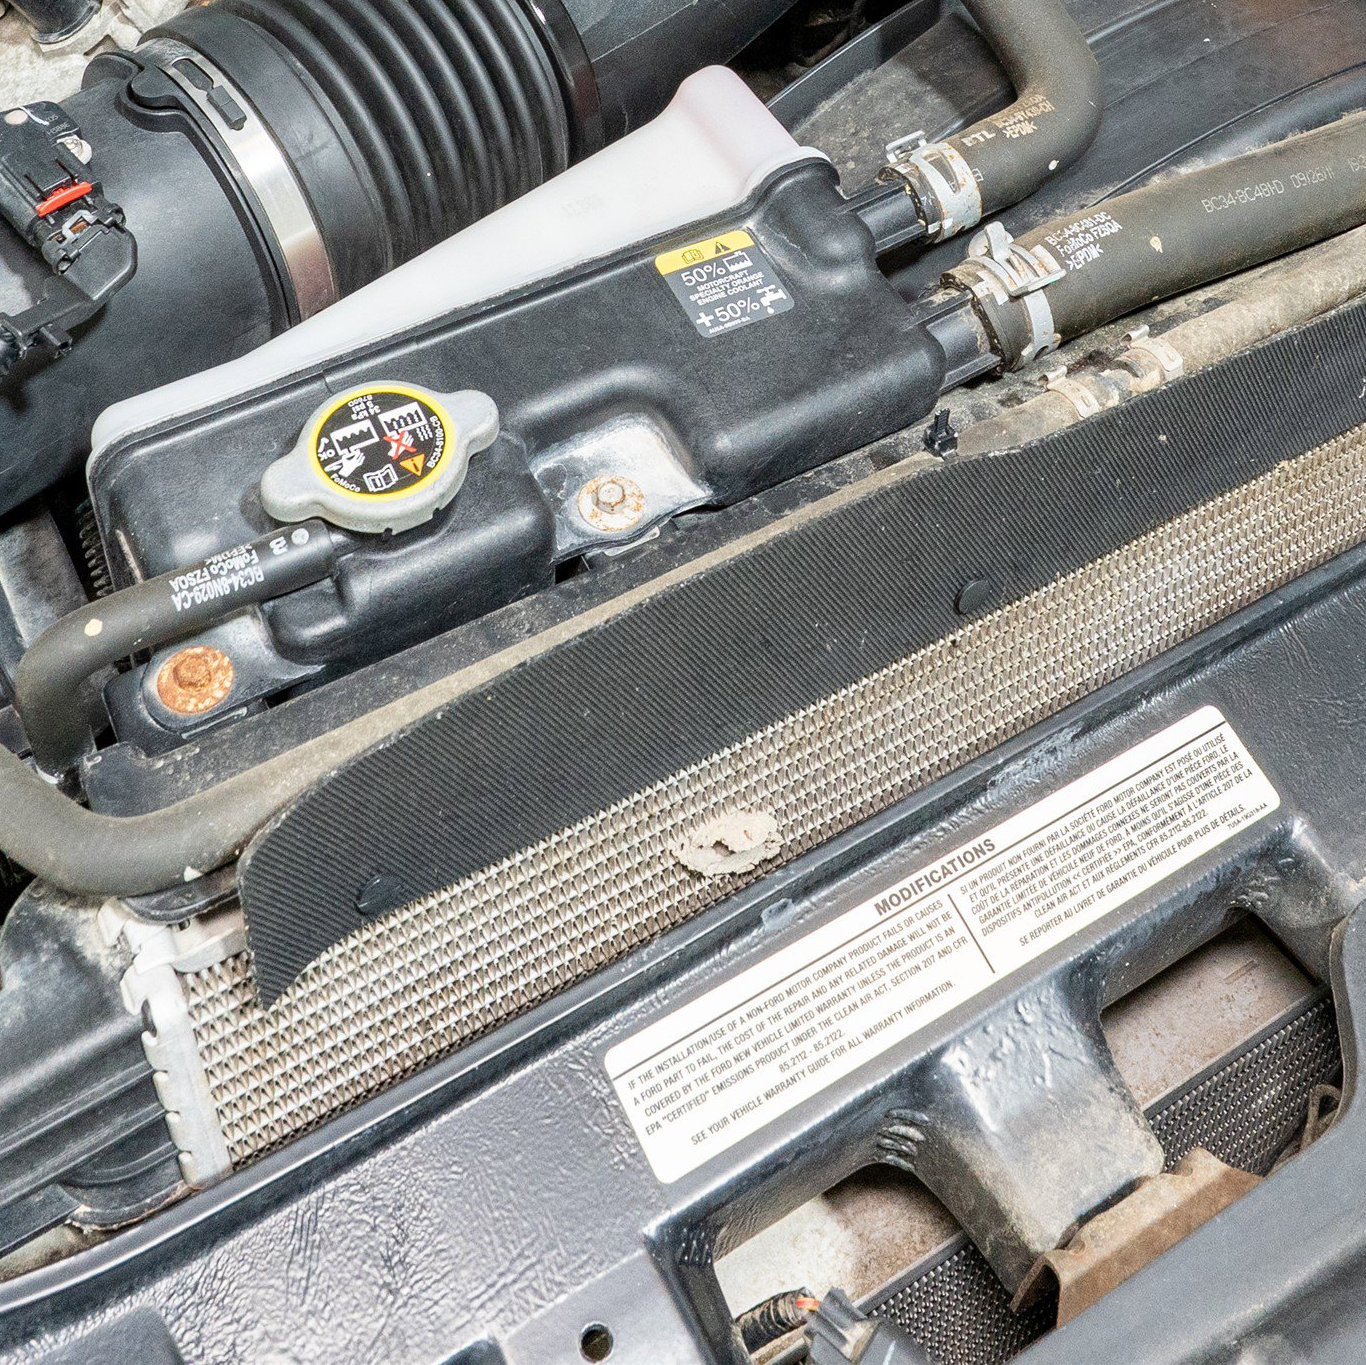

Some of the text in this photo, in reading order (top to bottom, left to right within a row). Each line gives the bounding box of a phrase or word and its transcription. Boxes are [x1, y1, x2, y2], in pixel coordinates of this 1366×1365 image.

[679, 259, 727, 288] 50%
[688, 270, 765, 302] SPECIALTY ORANGE
[695, 269, 749, 292] MOTORCRAFT
[696, 277, 764, 306] ENGINE COOLANT
[317, 449, 336, 461] OK
[329, 472, 361, 493] FoMoCo
[207, 548, 260, 579] FoMoCo
[959, 732, 1227, 895] SI UN PRODUIT NON FOURNI PAR LA SOCIÉTÉ FORD MOTOR COMPANY EST POSÉ OU UTILISÉ
[873, 836, 997, 916] MODIFICATIONS
[626, 1078, 638, 1090] IF
[636, 1068, 655, 1085] THE
[653, 1026, 728, 1075] INSTALLATION/USE
[725, 1018, 739, 1032] OF
[744, 991, 786, 1021] NON-FORD
[783, 975, 813, 998] MOTOR
[811, 954, 849, 981] COMPANY
[847, 934, 883, 960] PRODUCT
[881, 921, 904, 940] FAILS
[902, 915, 916, 928] OR
[913, 898, 944, 921] CAUSES
[638, 1081, 664, 1102] FORD
[662, 1068, 685, 1088] PART
[684, 1061, 698, 1075] TO
[695, 1049, 718, 1068] FAIL,
[716, 1039, 734, 1056] THE
[732, 1026, 756, 1046] COST
[754, 1019, 768, 1033] OF
[766, 1010, 784, 1026] THE
[782, 994, 811, 1016] REPAIR
[809, 983, 829, 1000] AND
[826, 974, 845, 990] ANY
[843, 954, 878, 980] RELATED
[875, 936, 908, 961] DAMAGE
[906, 925, 927, 942] WILL
[925, 916, 942, 931] NOT
[940, 910, 953, 923] BE
[643, 925, 956, 1118] COVERED BY THE FORD NEW VEHICLE LIMITED WARRANTY UNLESS THE PRODUCT IS AN
